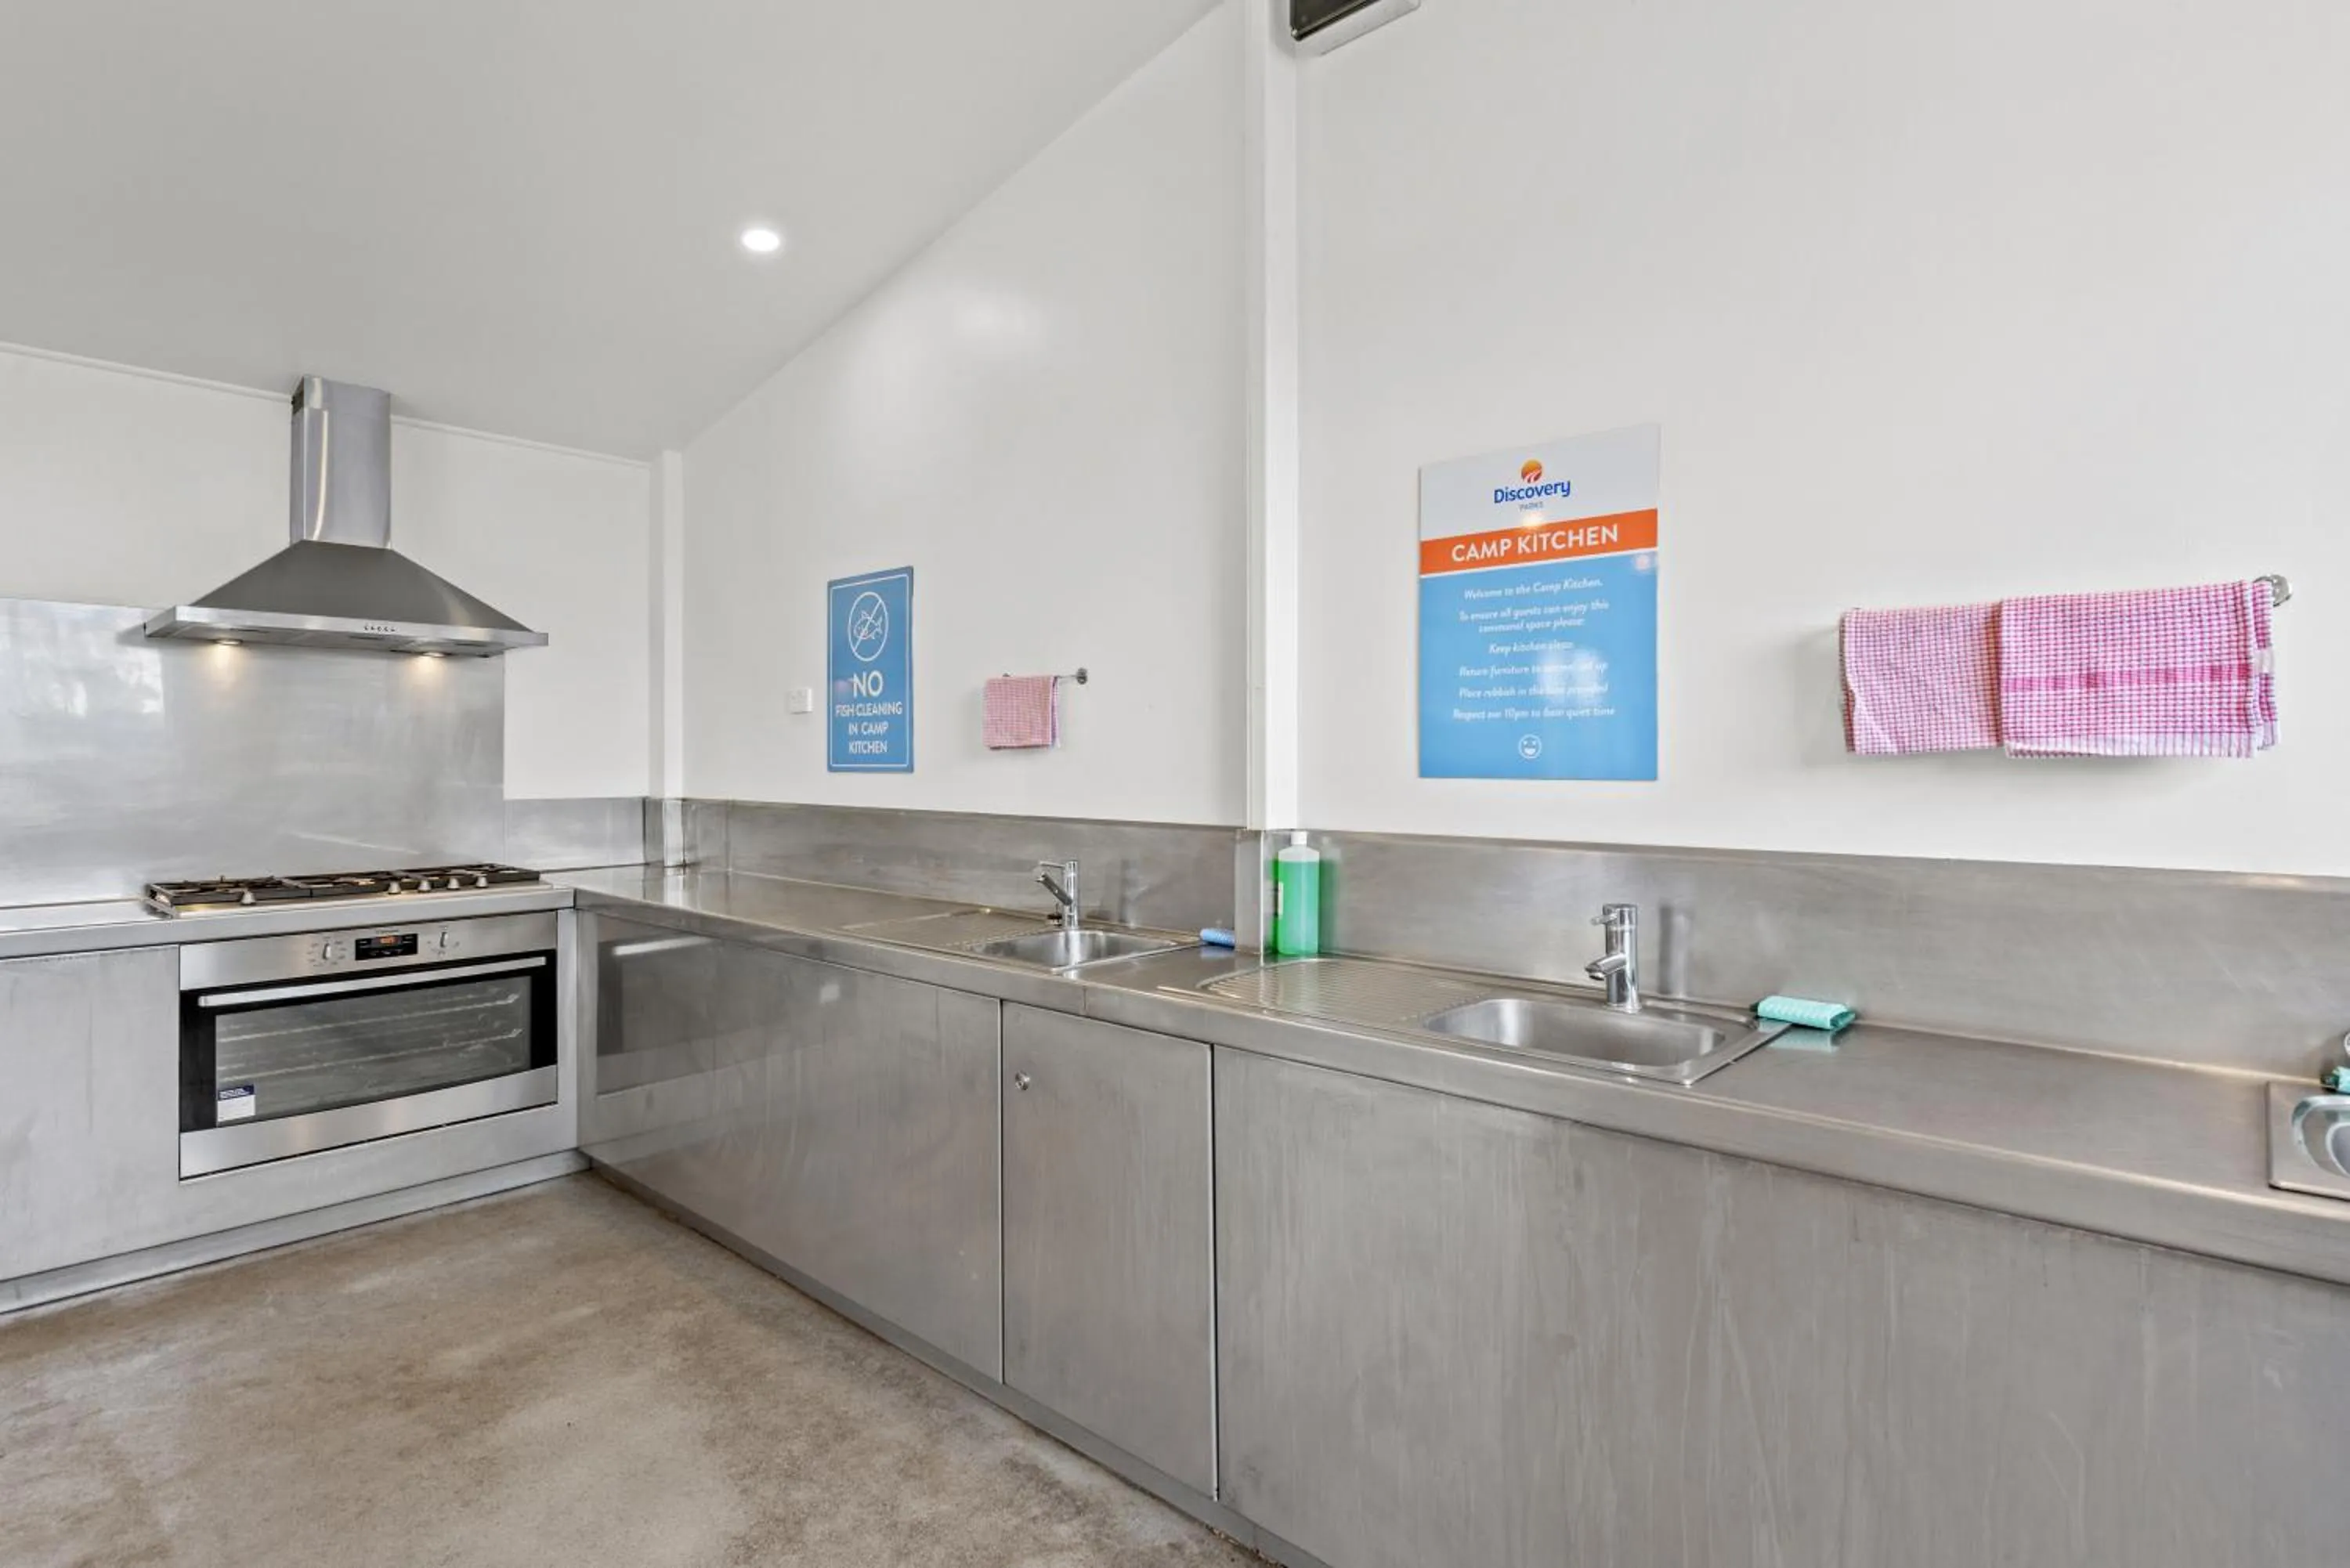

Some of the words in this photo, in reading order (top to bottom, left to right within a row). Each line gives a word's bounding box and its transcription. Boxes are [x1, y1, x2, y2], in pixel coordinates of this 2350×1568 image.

[1494, 479, 1571, 504] Discovery
[1452, 537, 1512, 562] CAMP
[1517, 523, 1618, 554] KITCHEN
[1464, 588, 1502, 600] Welcome
[1516, 584, 1530, 594] the
[1533, 582, 1560, 594] Camp
[1470, 612, 1498, 620] ensure
[1500, 608, 1511, 617] all
[1513, 607, 1541, 619] guests
[1543, 605, 1560, 614] can
[1563, 603, 1587, 615] enjoy
[1591, 598, 1609, 609] this
[1526, 621, 1553, 632] space
[1489, 643, 1510, 658] Keep
[1513, 641, 1546, 652] kitchen
[1459, 666, 1488, 677] Return
[1490, 664, 1530, 678] furniture
[853, 670, 884, 698] NO
[1459, 688, 1481, 699] Place
[1484, 687, 1516, 697] rubbish
[835, 703, 855, 717] FISH
[857, 701, 903, 717] CLEANING
[1453, 708, 1486, 721] Respect
[1566, 706, 1590, 720] quiet
[1593, 706, 1615, 716] time
[848, 722, 859, 735] IN
[861, 721, 888, 736] CAMP
[848, 739, 888, 754] KITCHEN
